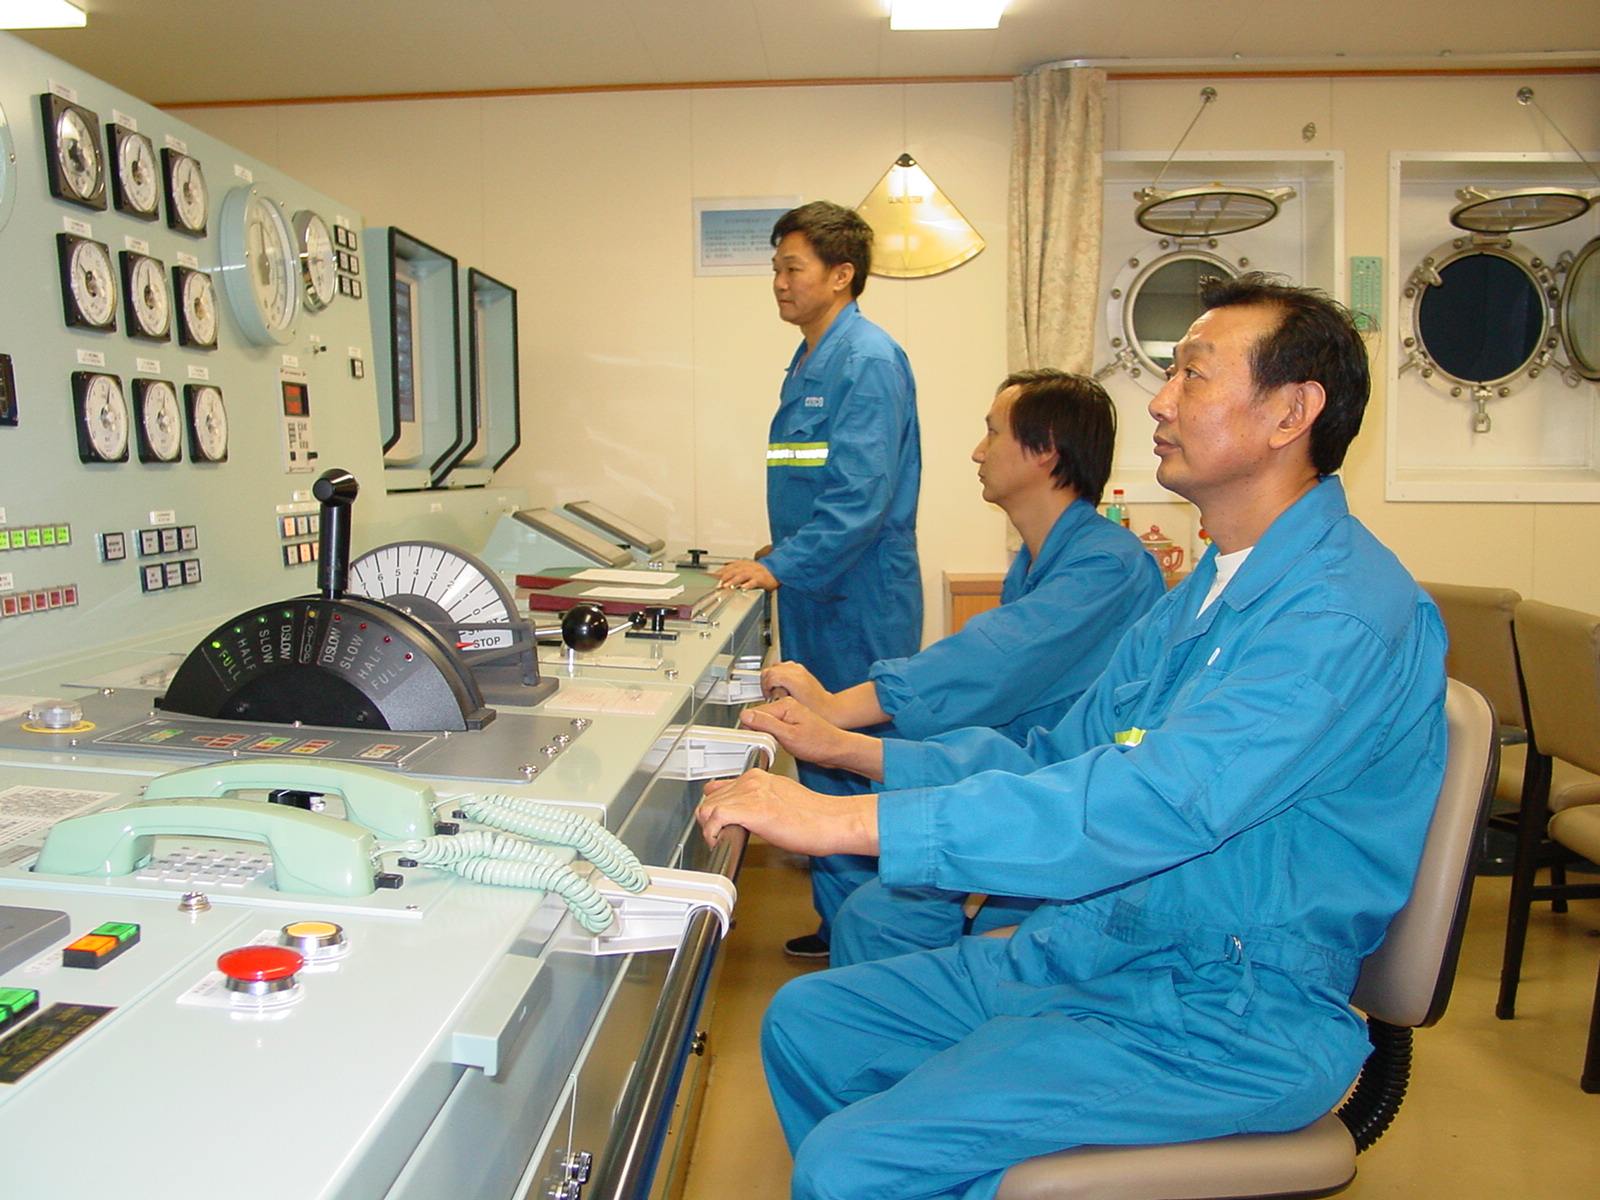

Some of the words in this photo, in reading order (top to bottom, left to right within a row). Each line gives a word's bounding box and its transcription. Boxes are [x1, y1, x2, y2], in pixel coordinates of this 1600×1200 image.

[237, 638, 257, 671] HALF
[259, 629, 274, 663] SLOW
[280, 624, 292, 660] DSLOW
[323, 627, 341, 663] DSLOW
[340, 634, 364, 670] SLOW
[473, 636, 501, 649] STOP
[219, 649, 241, 681] FULL
[357, 646, 384, 679] HALF
[371, 662, 406, 690] FULL
